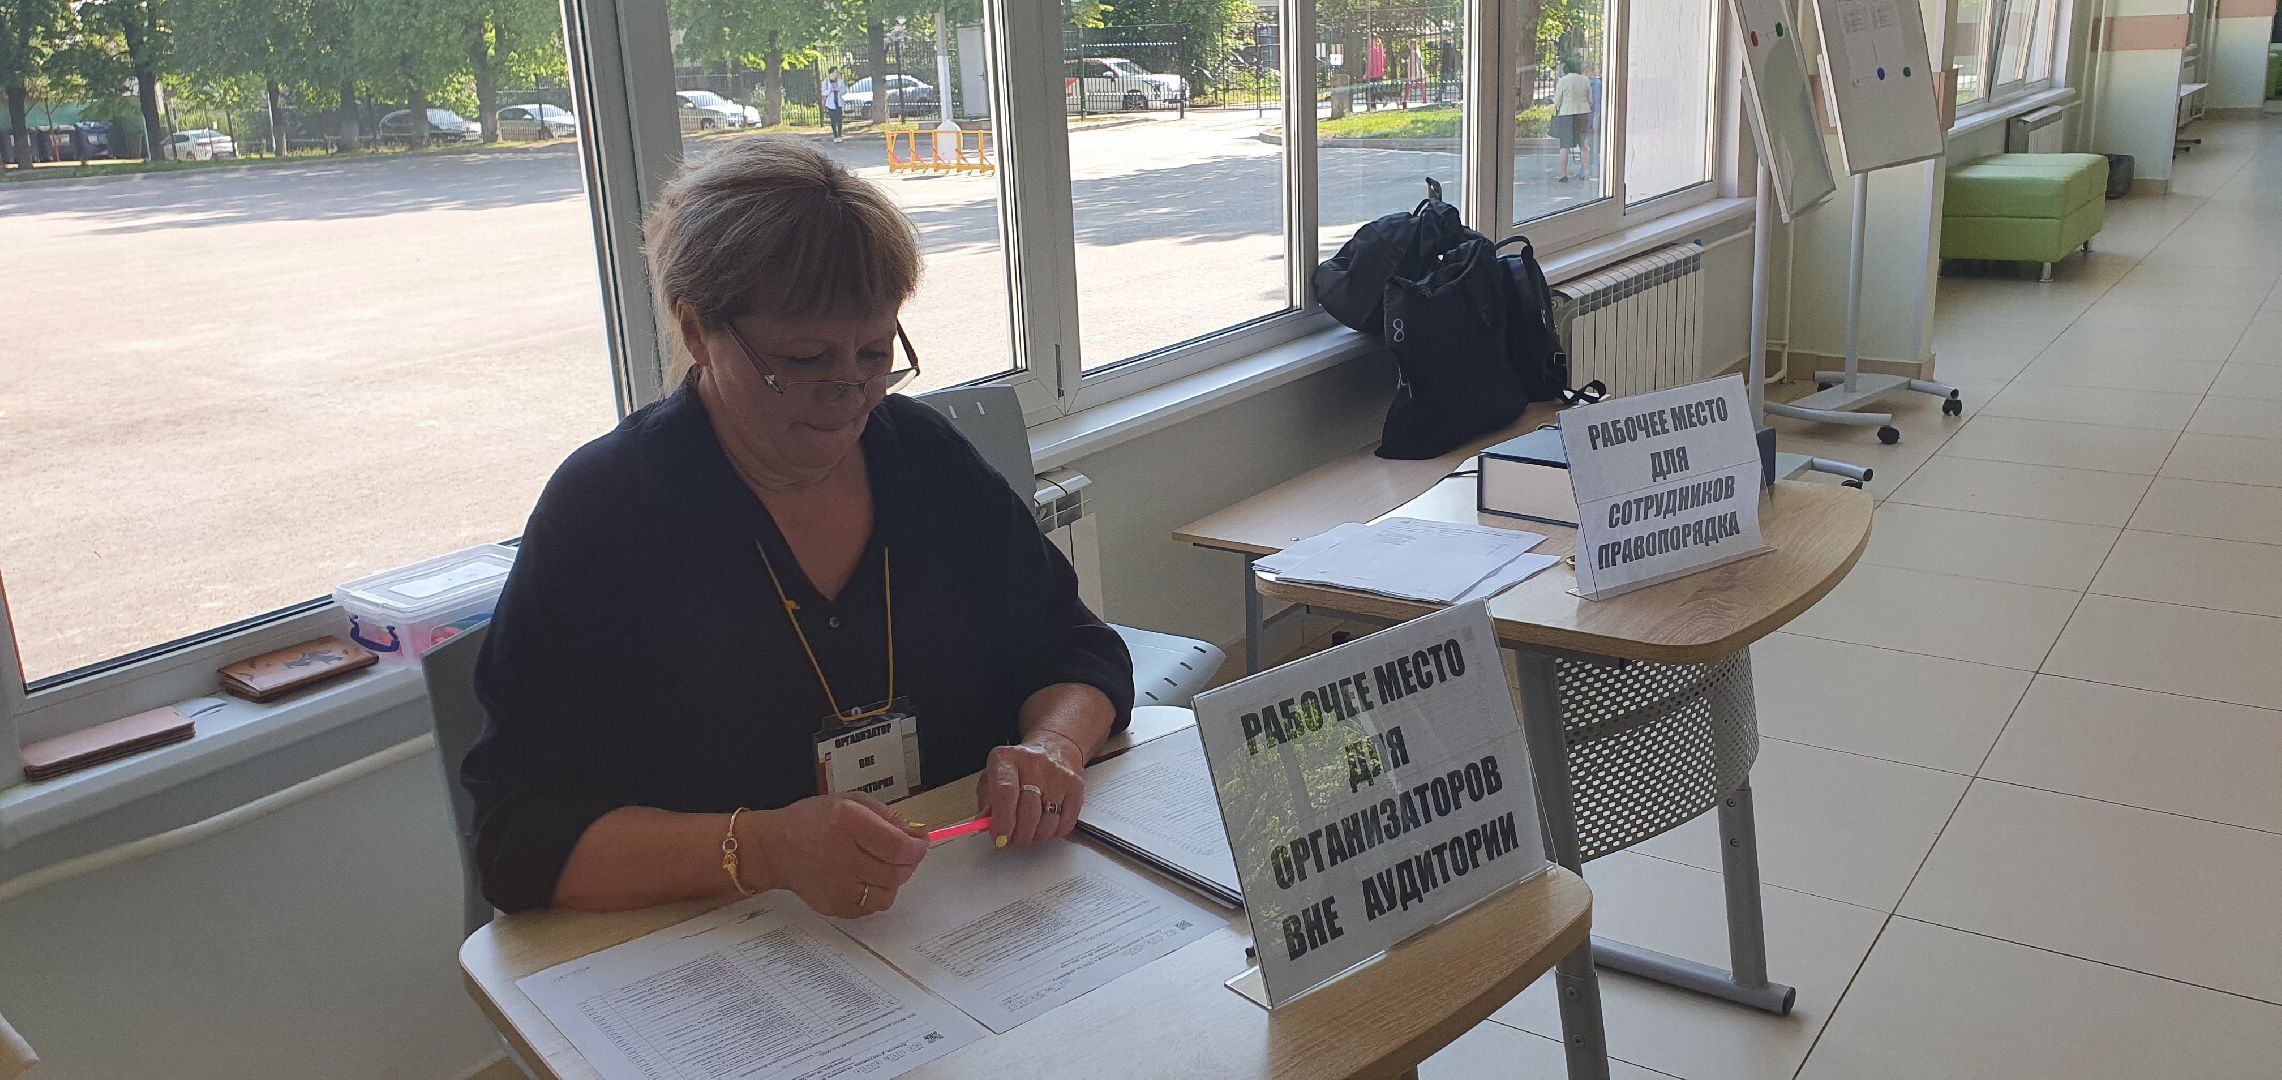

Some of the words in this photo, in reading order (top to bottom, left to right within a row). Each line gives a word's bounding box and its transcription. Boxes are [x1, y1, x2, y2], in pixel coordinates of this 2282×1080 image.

[1588, 409, 1670, 451] РАБОЧЕЕ
[1670, 396, 1728, 432] МЕСТО
[1650, 446, 1690, 483] ДЛЯ
[1608, 475, 1736, 529] СОТРУДНИКОВ
[1597, 511, 1741, 570] ПРАВОПОРЯДКА
[1240, 671, 1375, 756] РАБОЧЕЕ
[1376, 638, 1466, 706] МЕСТО
[835, 722, 892, 748] ОРГАНИЗАТОР
[859, 755, 875, 768] ВНЕ
[1270, 755, 1504, 890] ОРГАНИЗАТОРОВ
[1281, 895, 1345, 962] ВНЕ
[1361, 811, 1520, 922] АУДИТОРИИ
